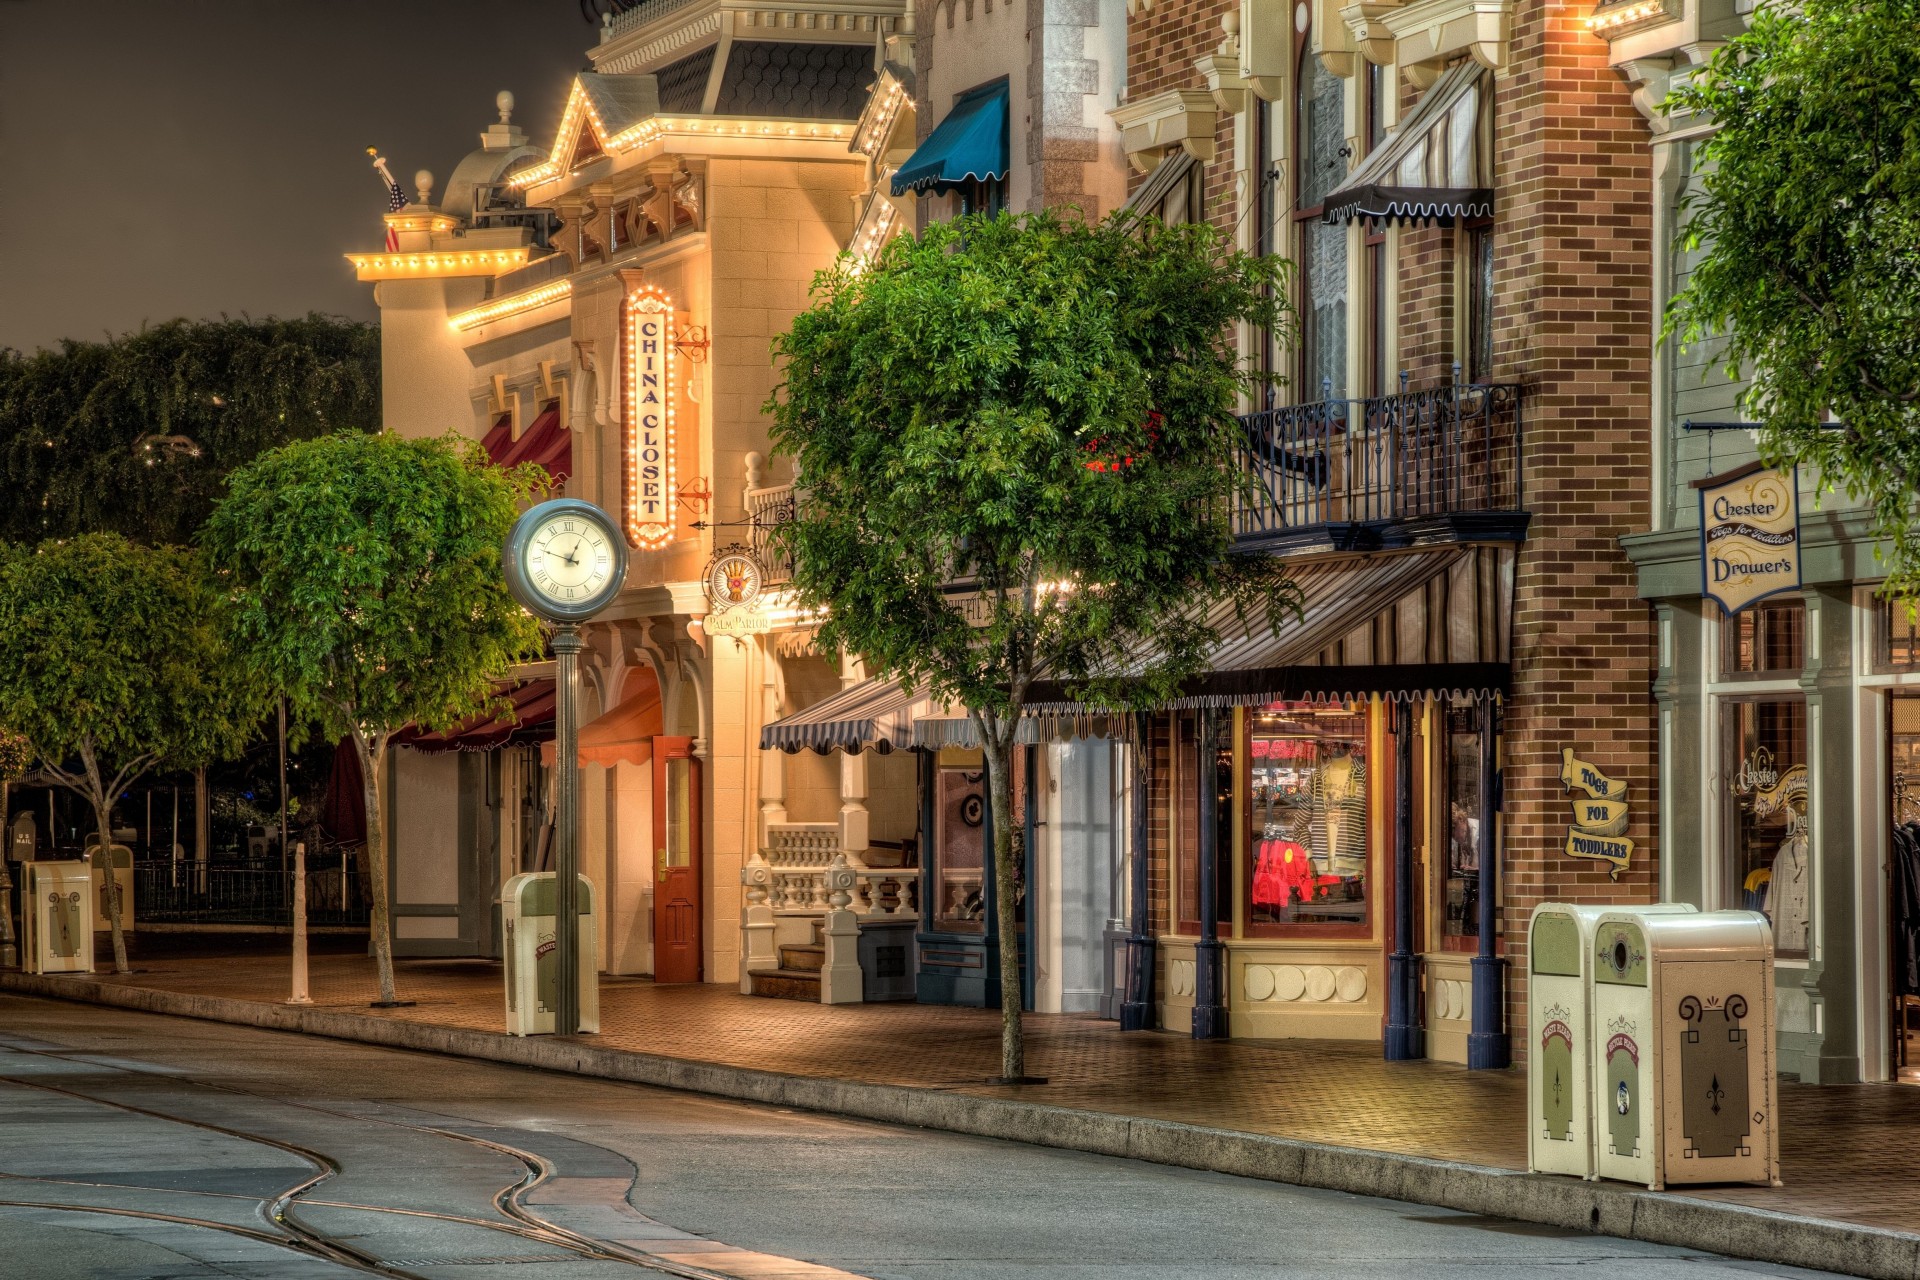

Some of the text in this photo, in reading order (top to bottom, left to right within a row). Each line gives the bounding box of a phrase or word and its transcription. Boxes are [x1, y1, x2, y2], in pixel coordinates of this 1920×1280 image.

[642, 322, 659, 404] CHINA
[642, 414, 660, 514] CLOSET
[1713, 495, 1775, 521] Chester
[548, 526, 557, 536] XI
[563, 521, 574, 532] XII
[1711, 524, 1794, 544] Togs for Toddlers
[592, 539, 602, 547] II
[597, 556, 606, 564] III
[1711, 557, 1792, 582] Drawer's
[548, 582, 558, 595] VII
[1581, 767, 1609, 795] TOGS
[1740, 759, 1778, 792] Chester
[1586, 806, 1609, 821] FOR
[1572, 836, 1628, 859] TODDLERS
